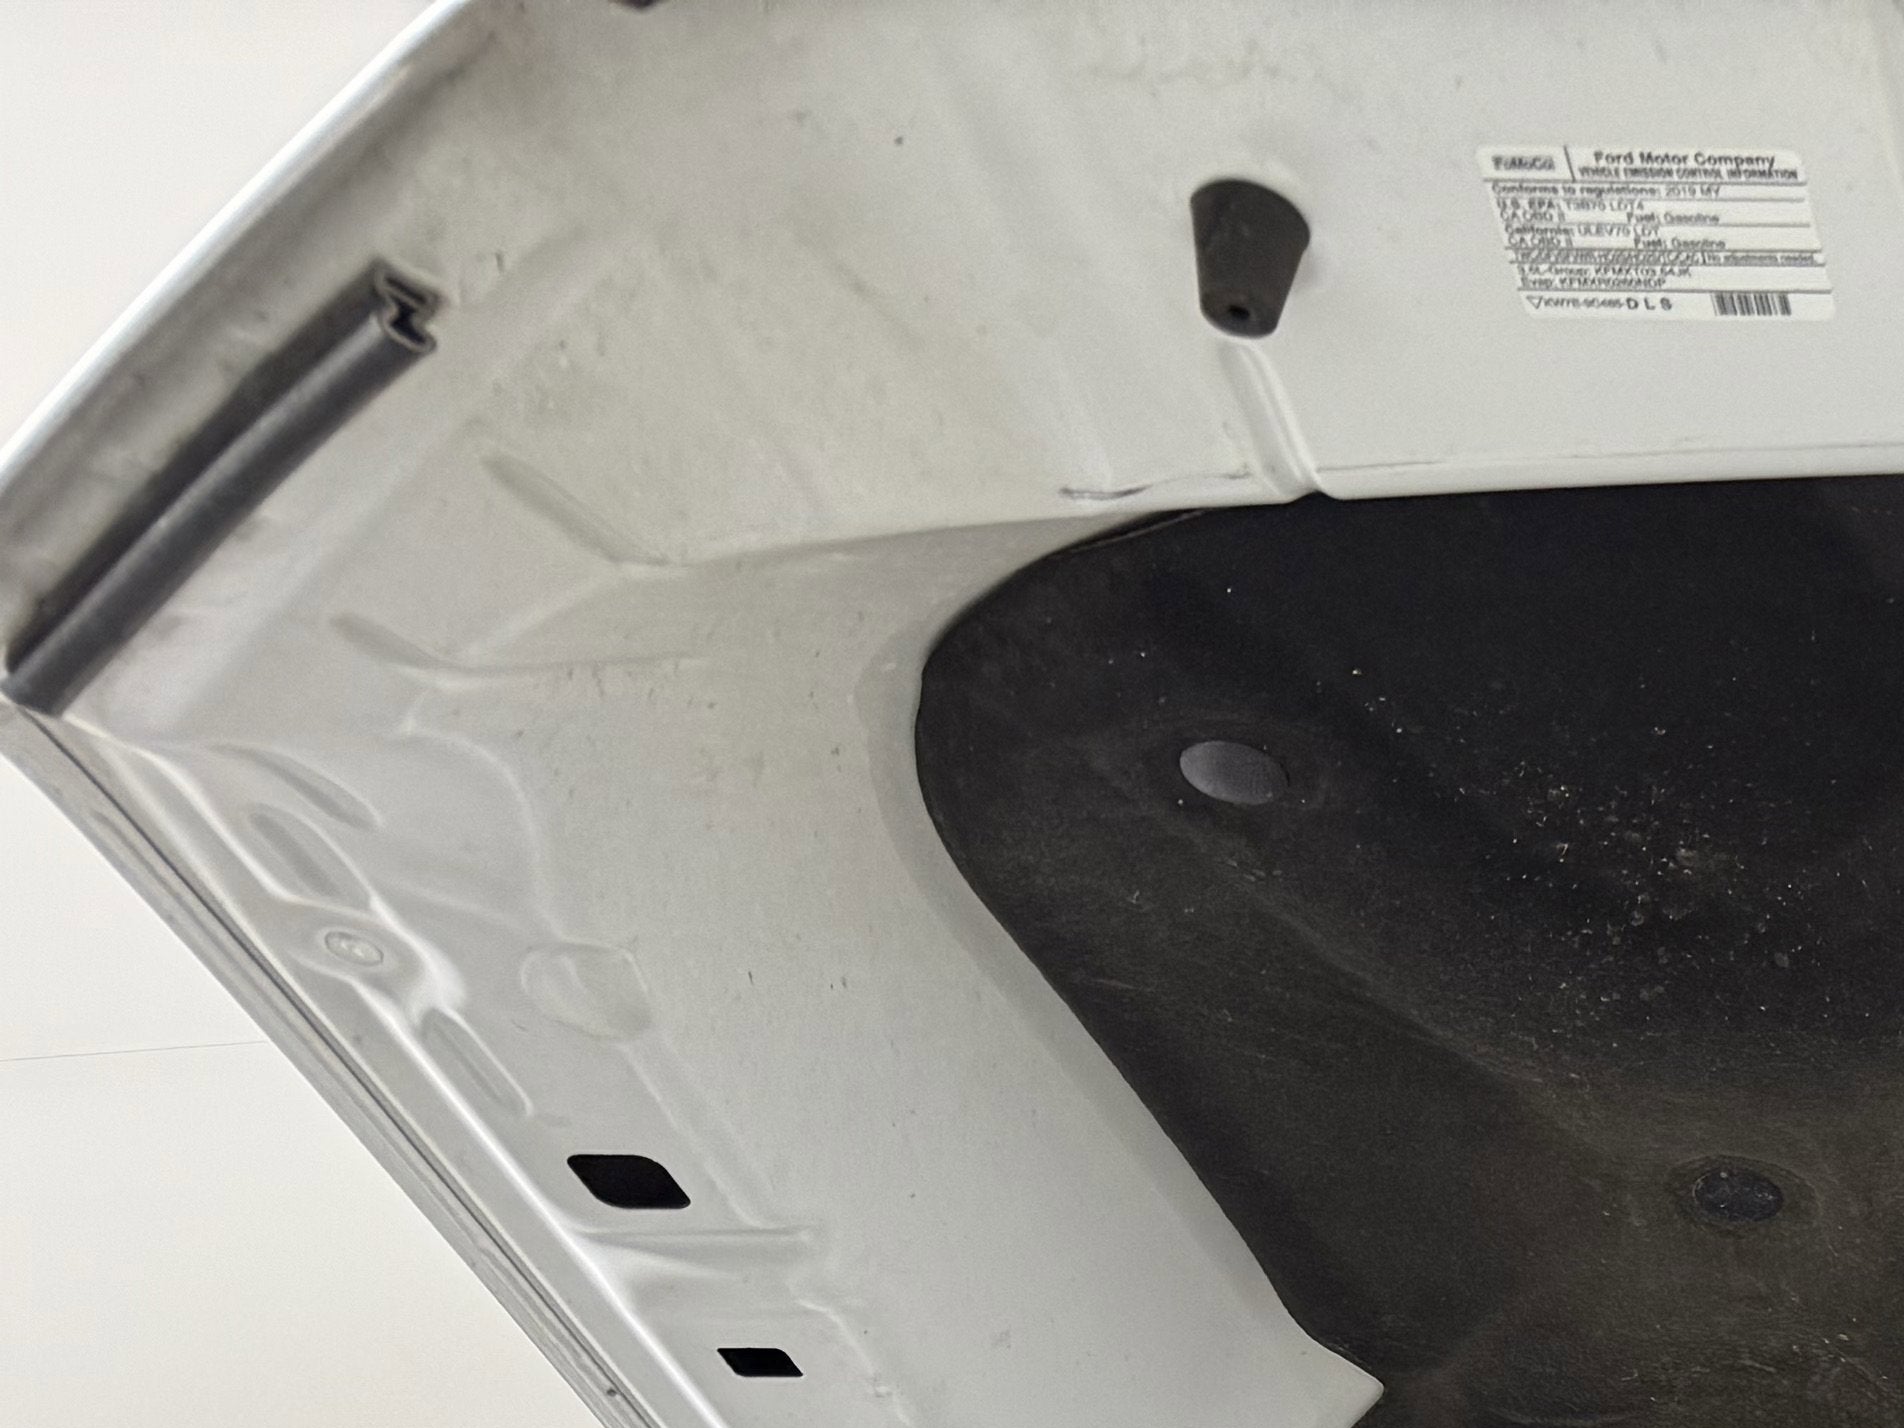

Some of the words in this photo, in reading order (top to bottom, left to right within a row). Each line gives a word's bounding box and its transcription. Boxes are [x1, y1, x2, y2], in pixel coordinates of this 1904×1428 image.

[1593, 151, 1633, 165] Ford
[1639, 152, 1689, 166] Motor
[1694, 152, 1775, 170] Company
[1727, 169, 1798, 179] INFORMATION
